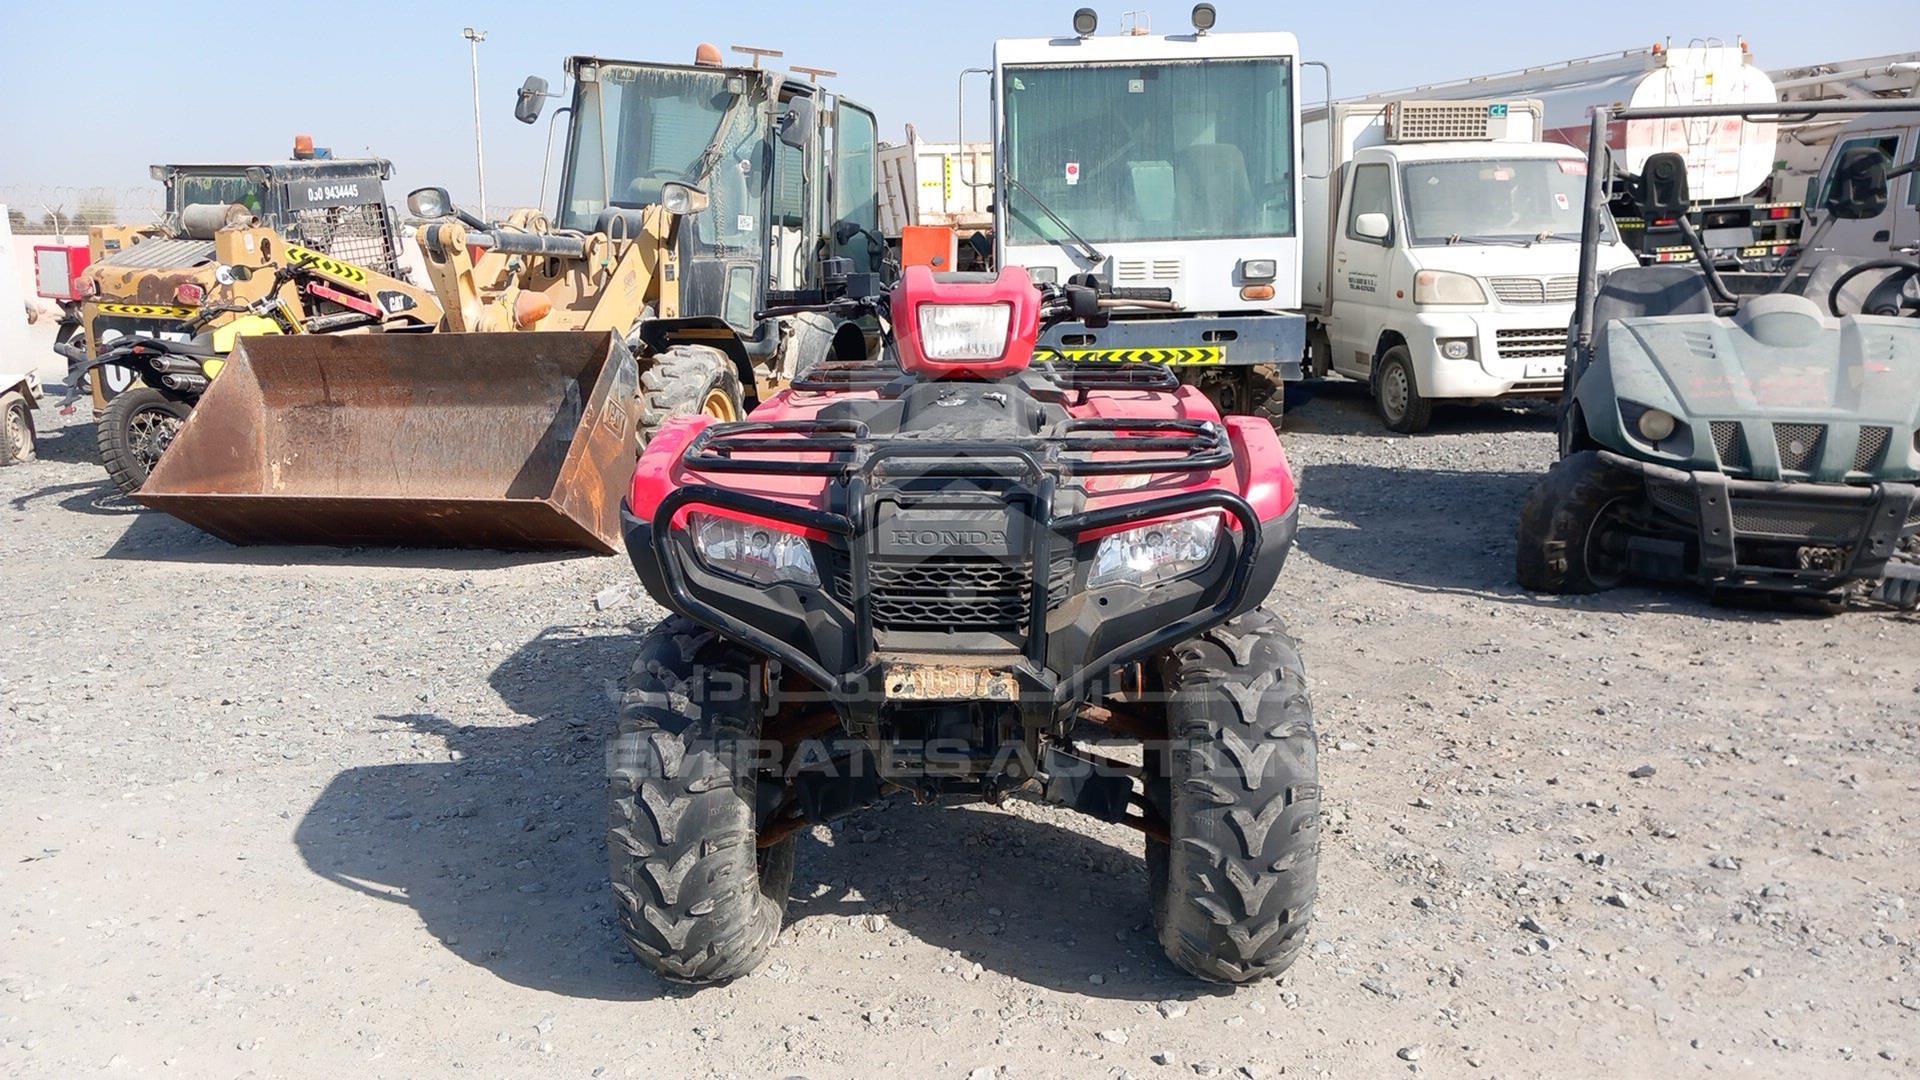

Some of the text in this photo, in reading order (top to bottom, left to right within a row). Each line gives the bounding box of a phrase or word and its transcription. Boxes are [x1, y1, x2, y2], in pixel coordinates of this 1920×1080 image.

[324, 184, 359, 200] 9434445
[388, 294, 405, 311] CAT
[890, 529, 1012, 547] HONDA
